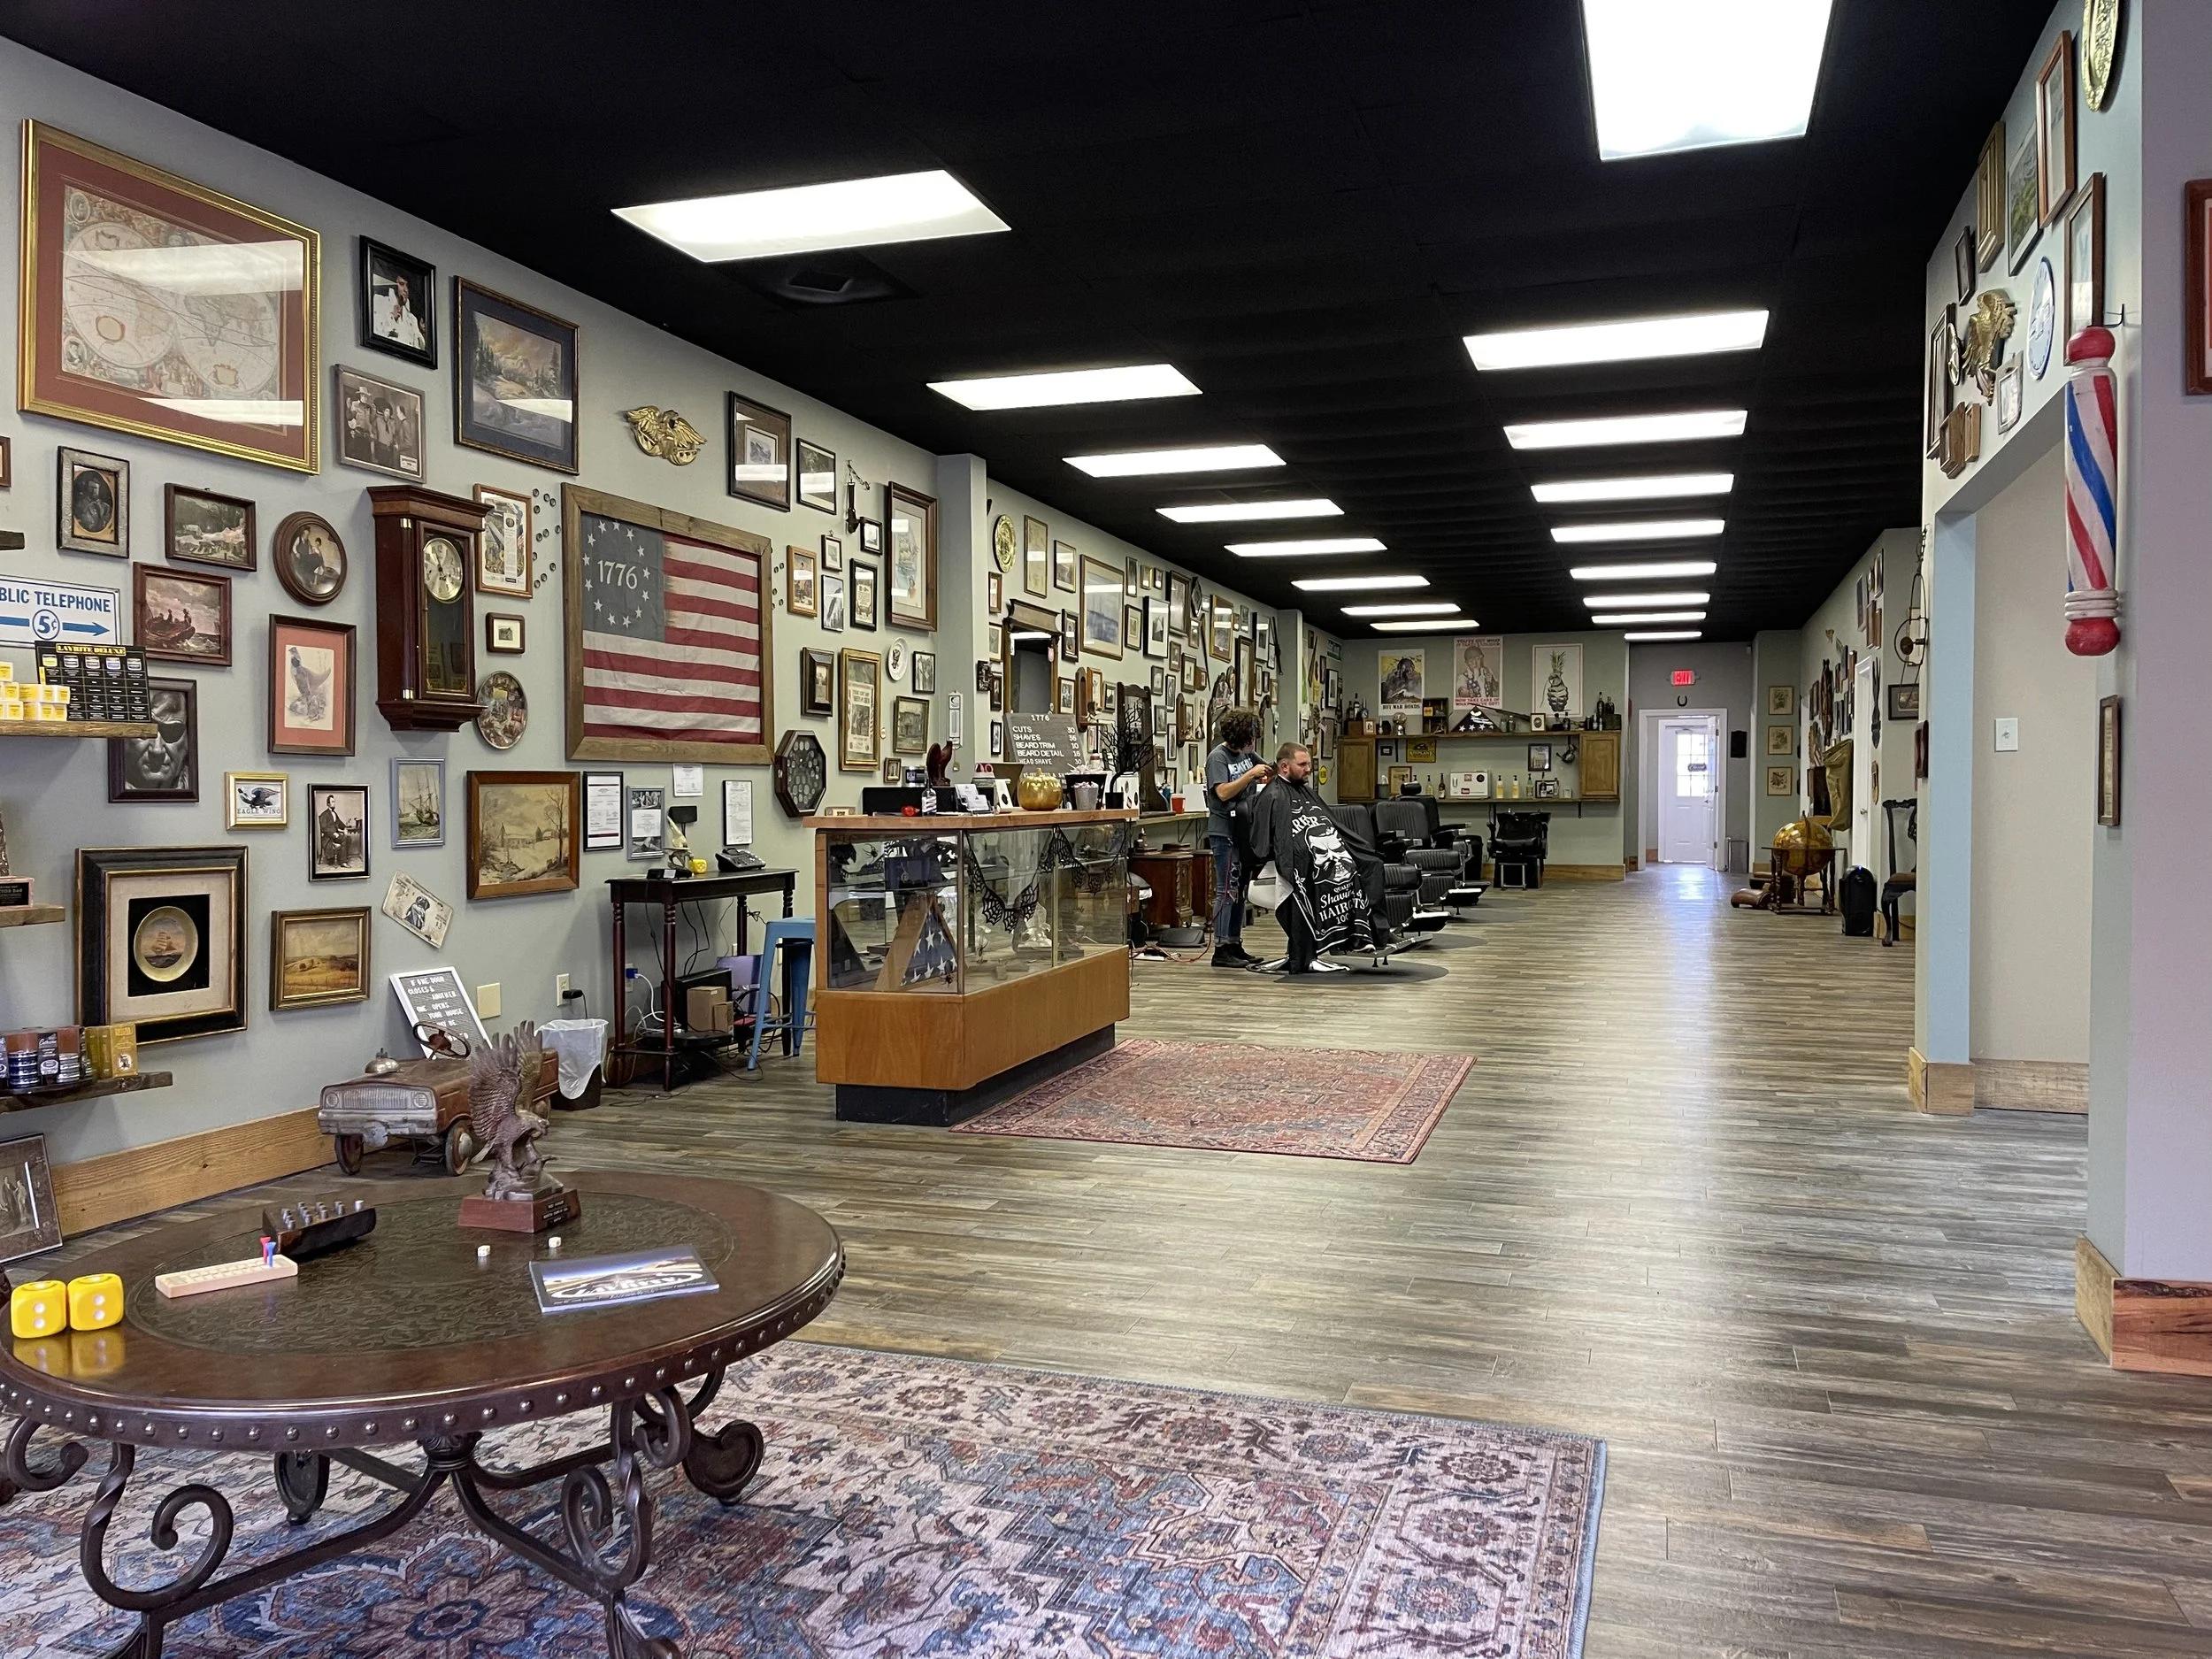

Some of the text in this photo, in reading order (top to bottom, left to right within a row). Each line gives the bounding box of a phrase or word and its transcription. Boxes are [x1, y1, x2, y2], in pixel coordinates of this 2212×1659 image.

[597, 560, 637, 589] 1776
[0, 588, 111, 612] BLIC TELEPHONE
[432, 991, 456, 1000] ANOTHER
